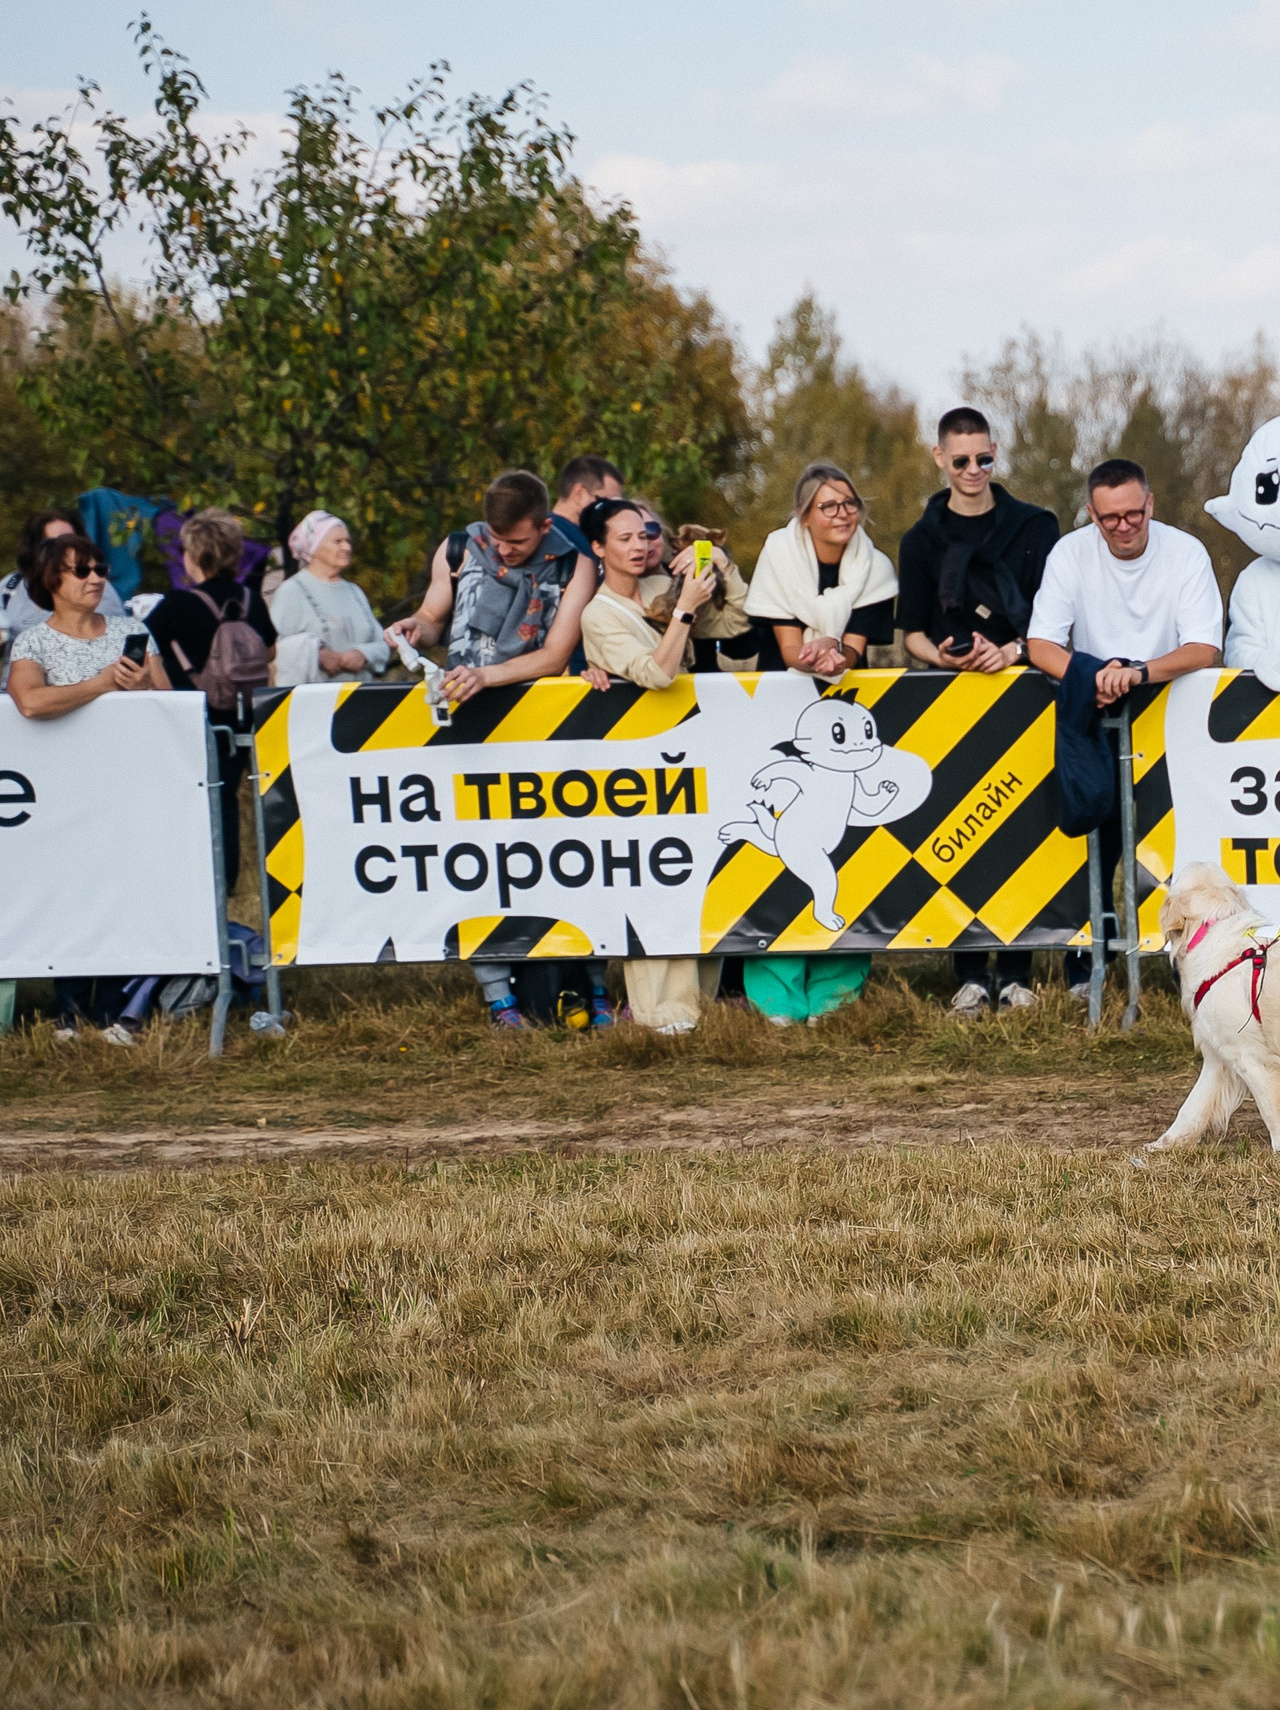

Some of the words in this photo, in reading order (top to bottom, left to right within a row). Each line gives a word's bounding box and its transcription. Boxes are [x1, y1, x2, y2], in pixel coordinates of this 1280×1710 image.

[349, 773, 441, 823] на
[463, 752, 697, 820] твоей
[932, 772, 1022, 863] билайн
[354, 837, 693, 908] стороне
